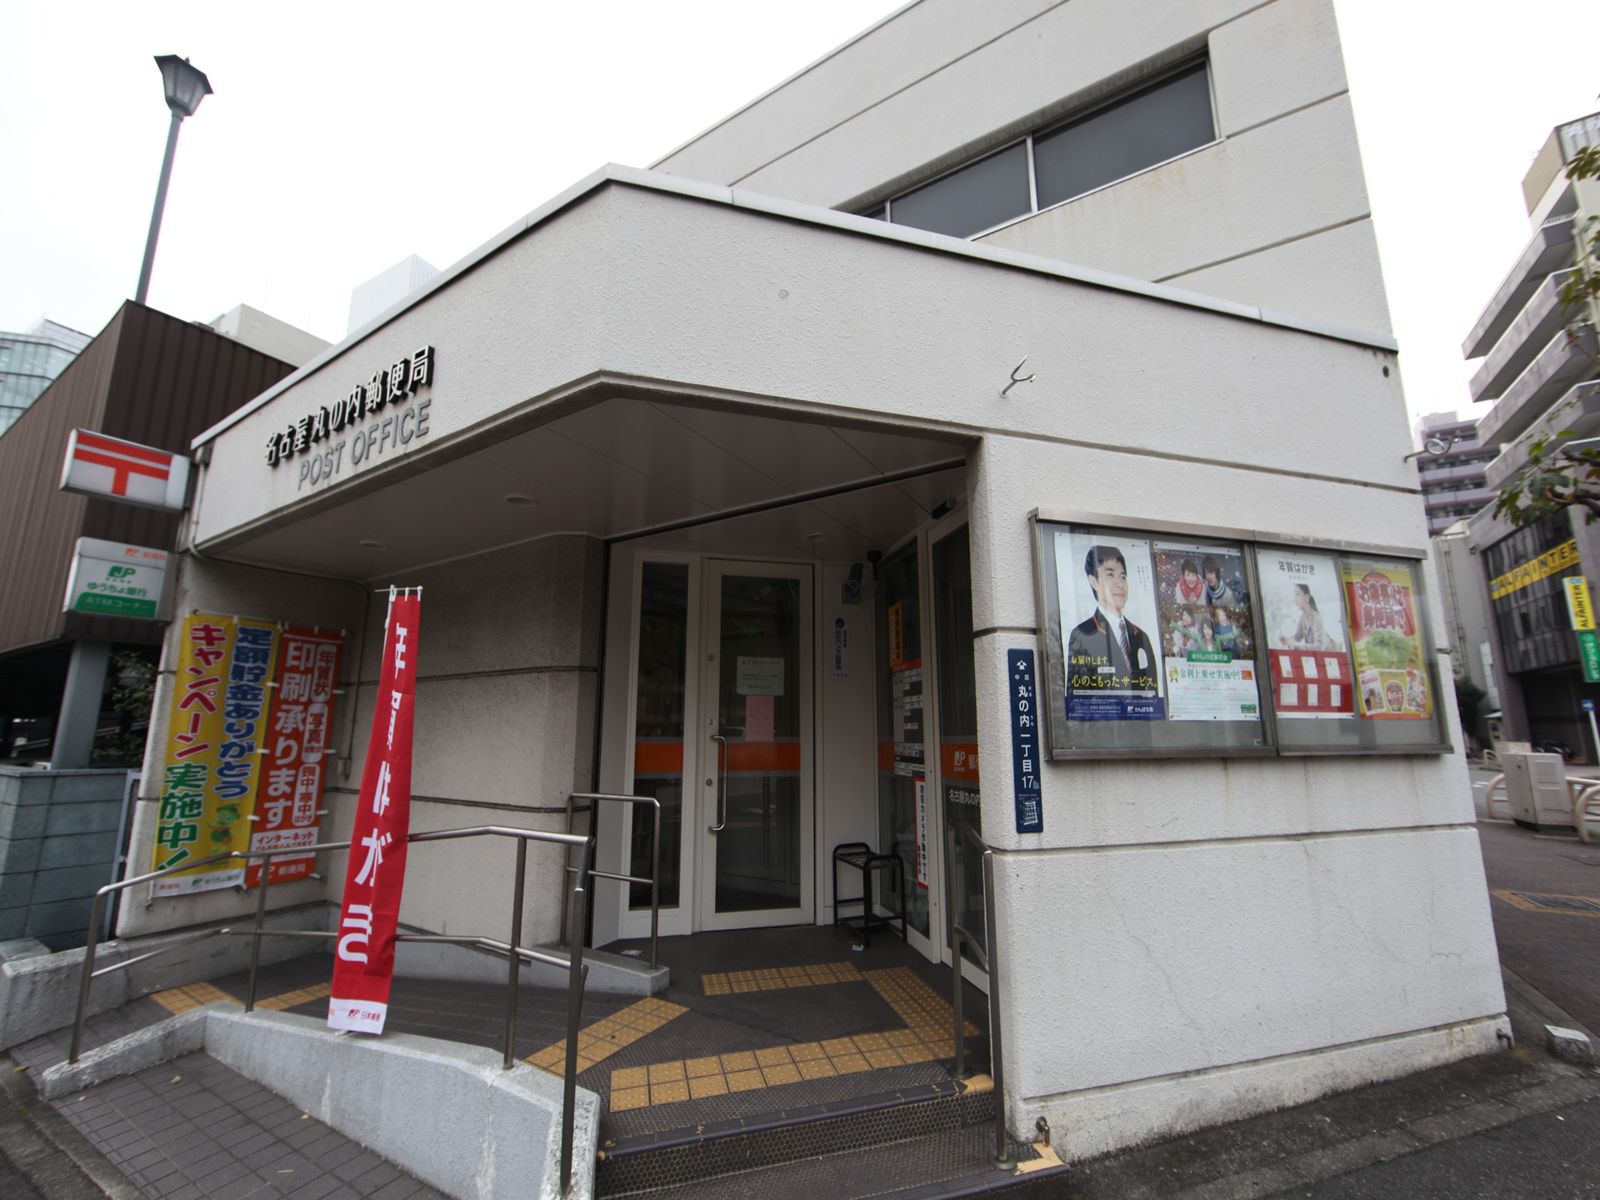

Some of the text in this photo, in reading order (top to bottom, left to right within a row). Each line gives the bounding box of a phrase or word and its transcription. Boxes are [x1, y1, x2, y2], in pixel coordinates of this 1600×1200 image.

[265, 345, 434, 467] 名古屋丸の内郵便局
[297, 399, 431, 491] POST OFFICE
[108, 565, 136, 579] JP
[1278, 560, 1315, 575] 年賀はがき
[85, 597, 150, 609] ATMコーナー
[86, 581, 148, 597] ゆうちょ銀行
[314, 650, 334, 696] 年賀状
[213, 626, 273, 799] 定額貯金ありがとう
[264, 641, 315, 829] 印刷承ります
[257, 832, 313, 845] インターネット
